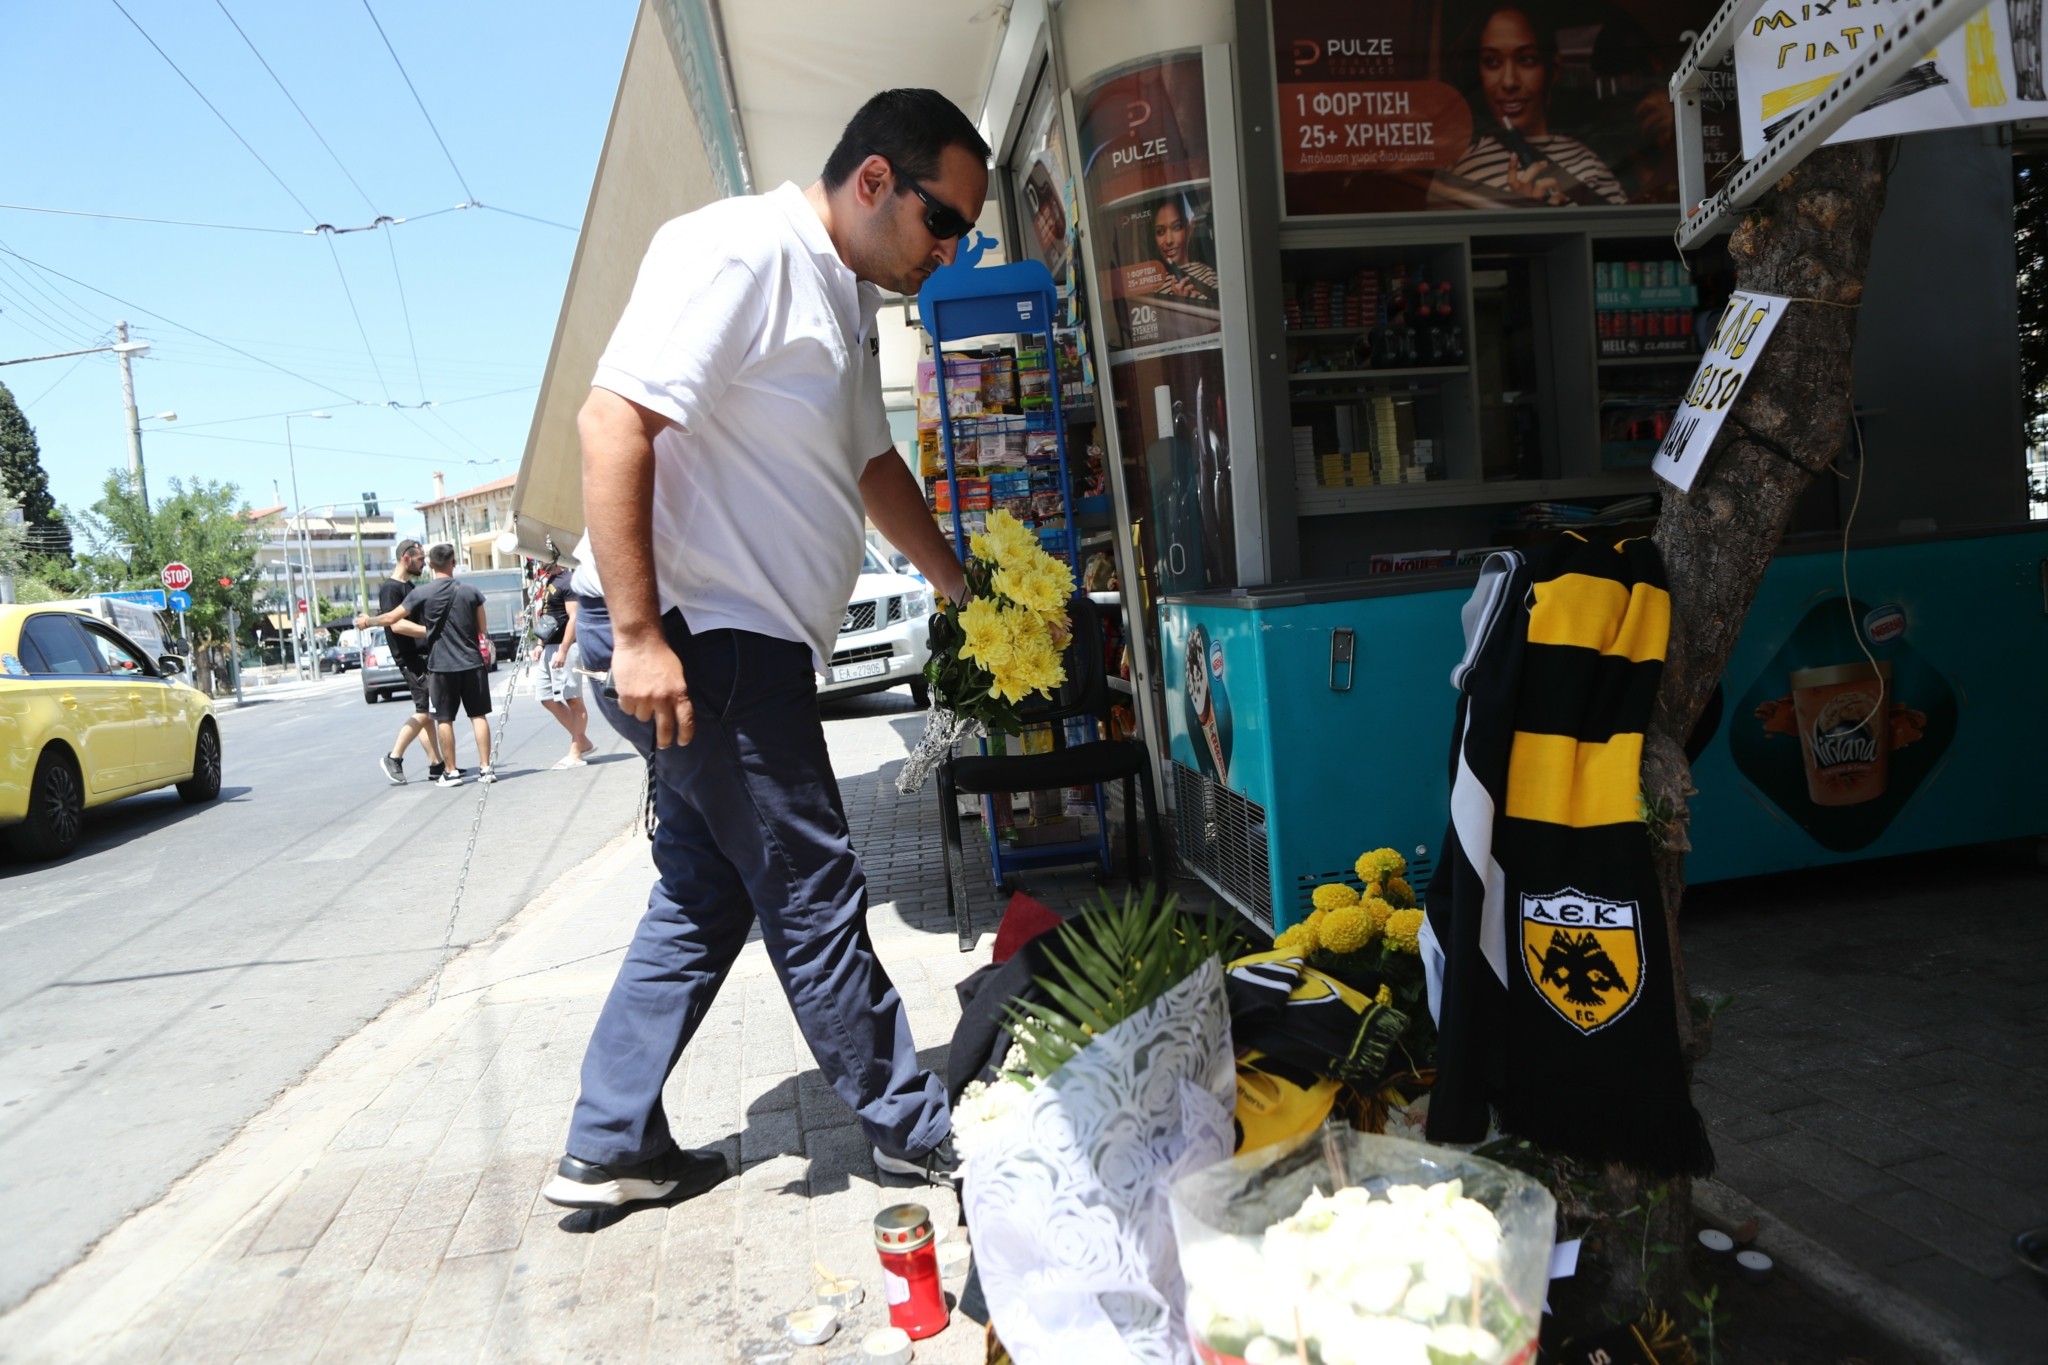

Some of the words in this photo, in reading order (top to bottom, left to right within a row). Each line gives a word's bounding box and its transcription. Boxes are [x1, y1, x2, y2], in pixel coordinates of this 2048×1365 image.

[1327, 38, 1394, 57] PULZE
[1296, 93, 1306, 117] 1
[1313, 91, 1410, 117] ΦΟΡΤΙΣΗ
[1299, 124, 1339, 149] 25+
[1344, 122, 1435, 148] ΧΡΗΣΕΙΣ
[1112, 137, 1168, 168] PULZE
[1130, 209, 1152, 220] PULZE
[1131, 305, 1157, 326] 20€
[1601, 339, 1626, 353] HELL
[1644, 340, 1688, 350] CLASSIC
[164, 570, 189, 584] STOP
[1804, 722, 1878, 769] Nirvana
